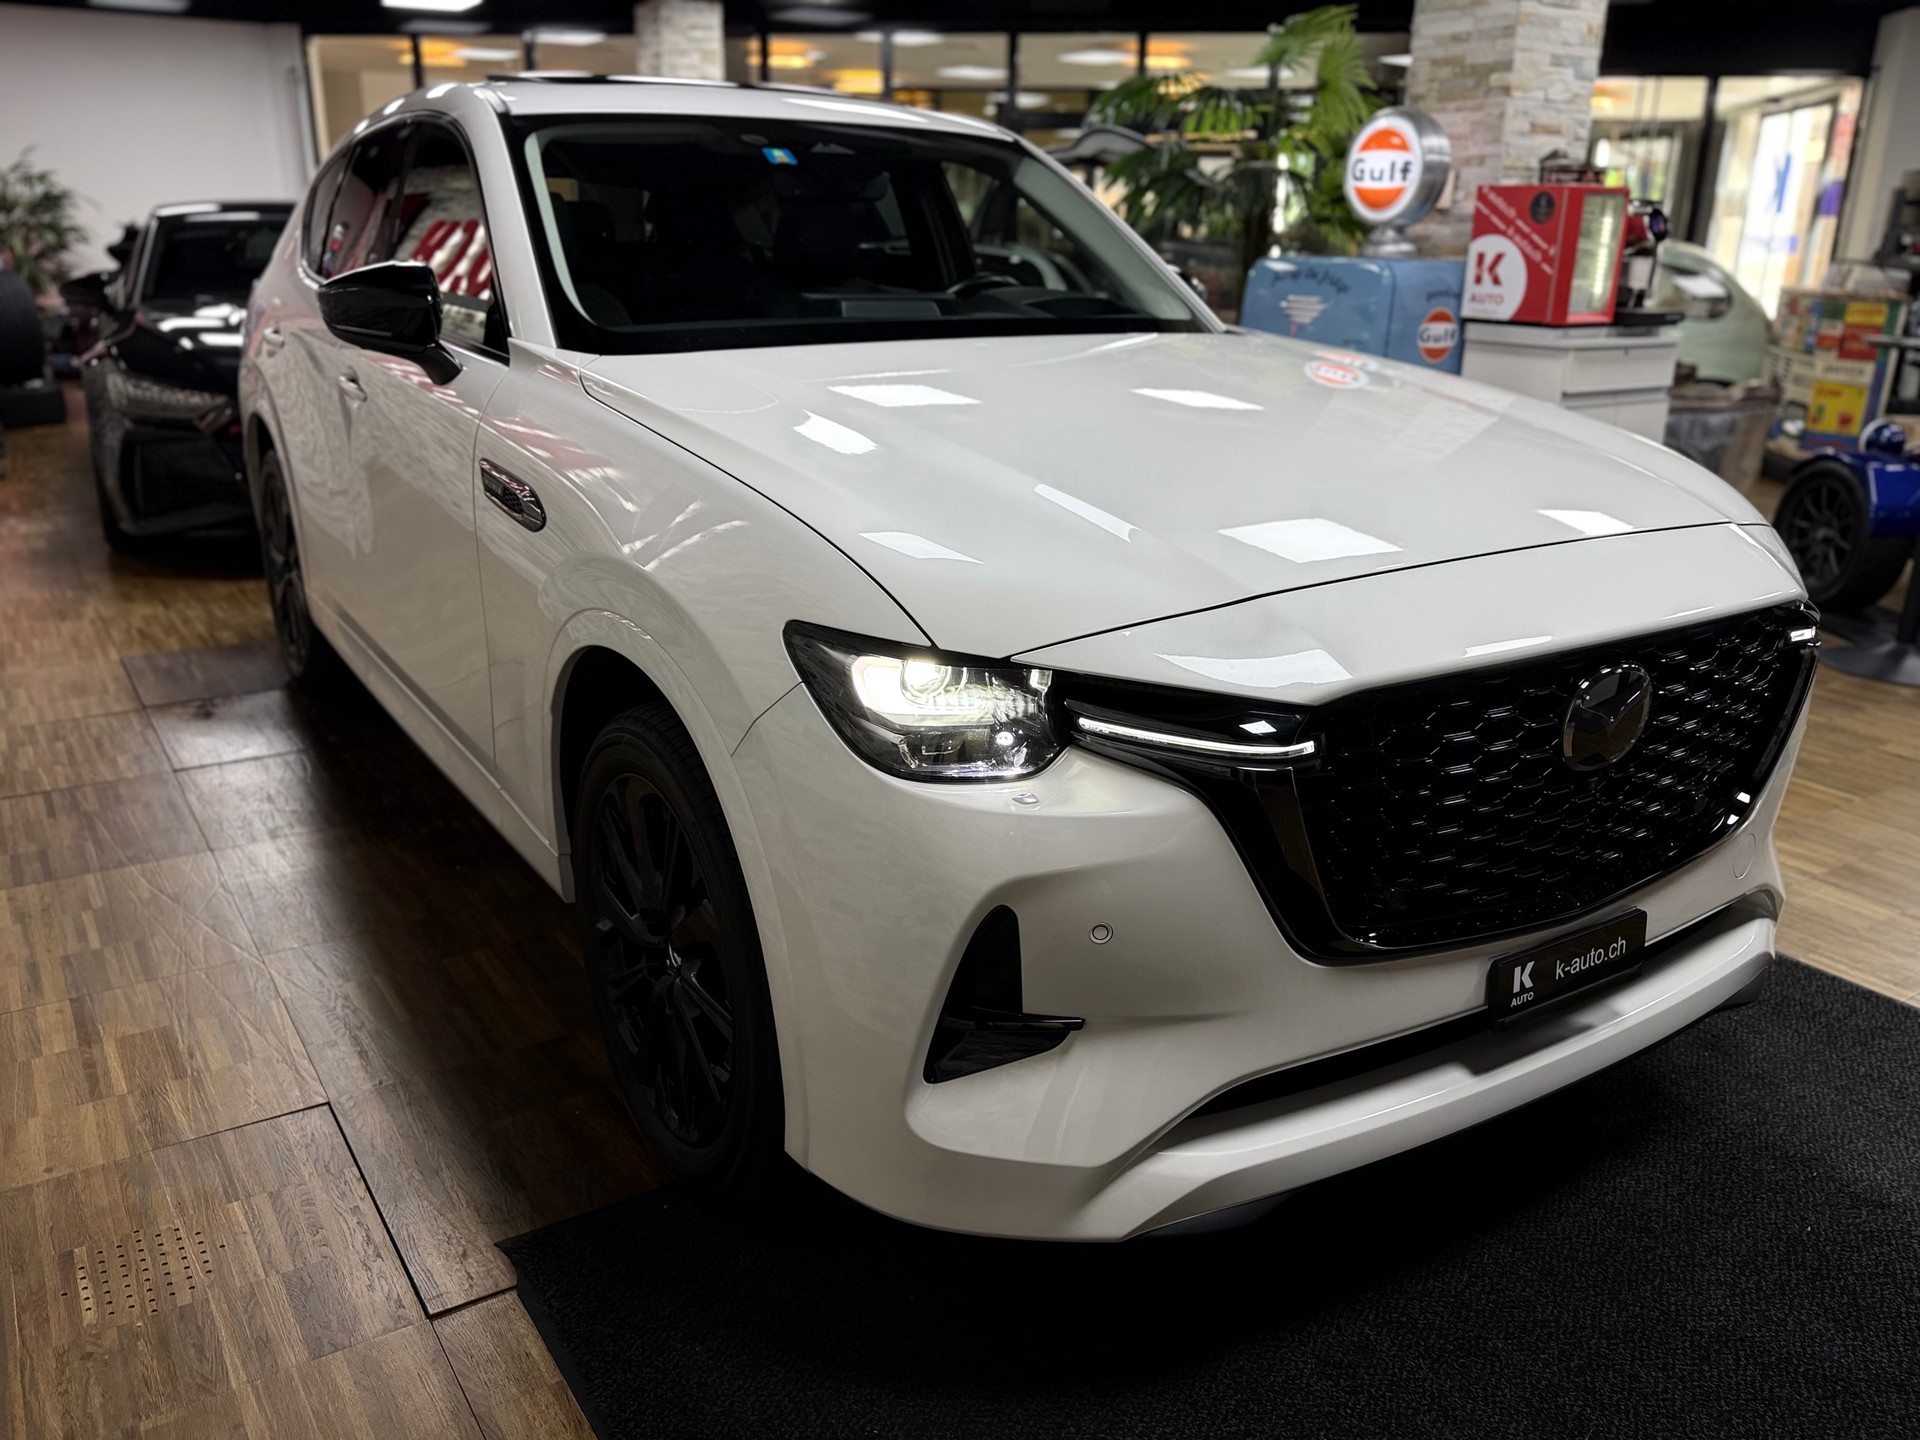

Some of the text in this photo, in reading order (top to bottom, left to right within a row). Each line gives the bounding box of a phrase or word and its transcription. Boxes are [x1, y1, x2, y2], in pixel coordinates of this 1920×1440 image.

[1352, 159, 1412, 182] Gulf
[1474, 252, 1506, 286] K
[1470, 293, 1504, 305] AUTO
[1420, 326, 1457, 343] Gulf
[1555, 936, 1626, 980] k-auto.ch
[1512, 960, 1535, 994] K
[1510, 991, 1534, 1008] AUTO
